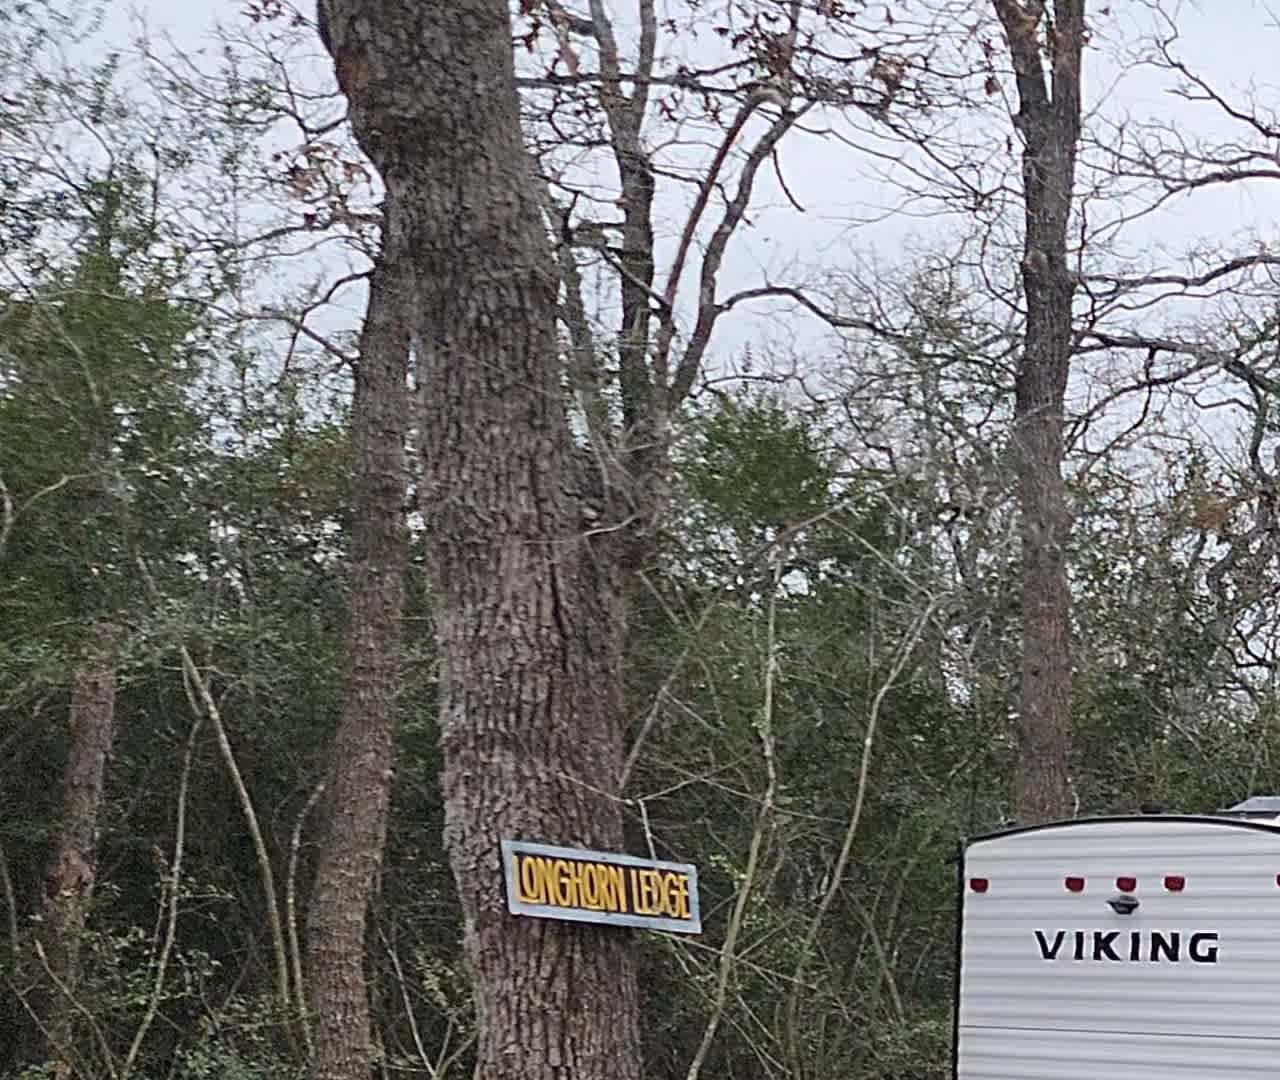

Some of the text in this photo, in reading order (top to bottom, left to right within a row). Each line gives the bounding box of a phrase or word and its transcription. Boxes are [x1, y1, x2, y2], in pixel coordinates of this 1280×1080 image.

[512, 855, 692, 918] LONGHORN LEDGE
[1035, 930, 1218, 963] VIKING
